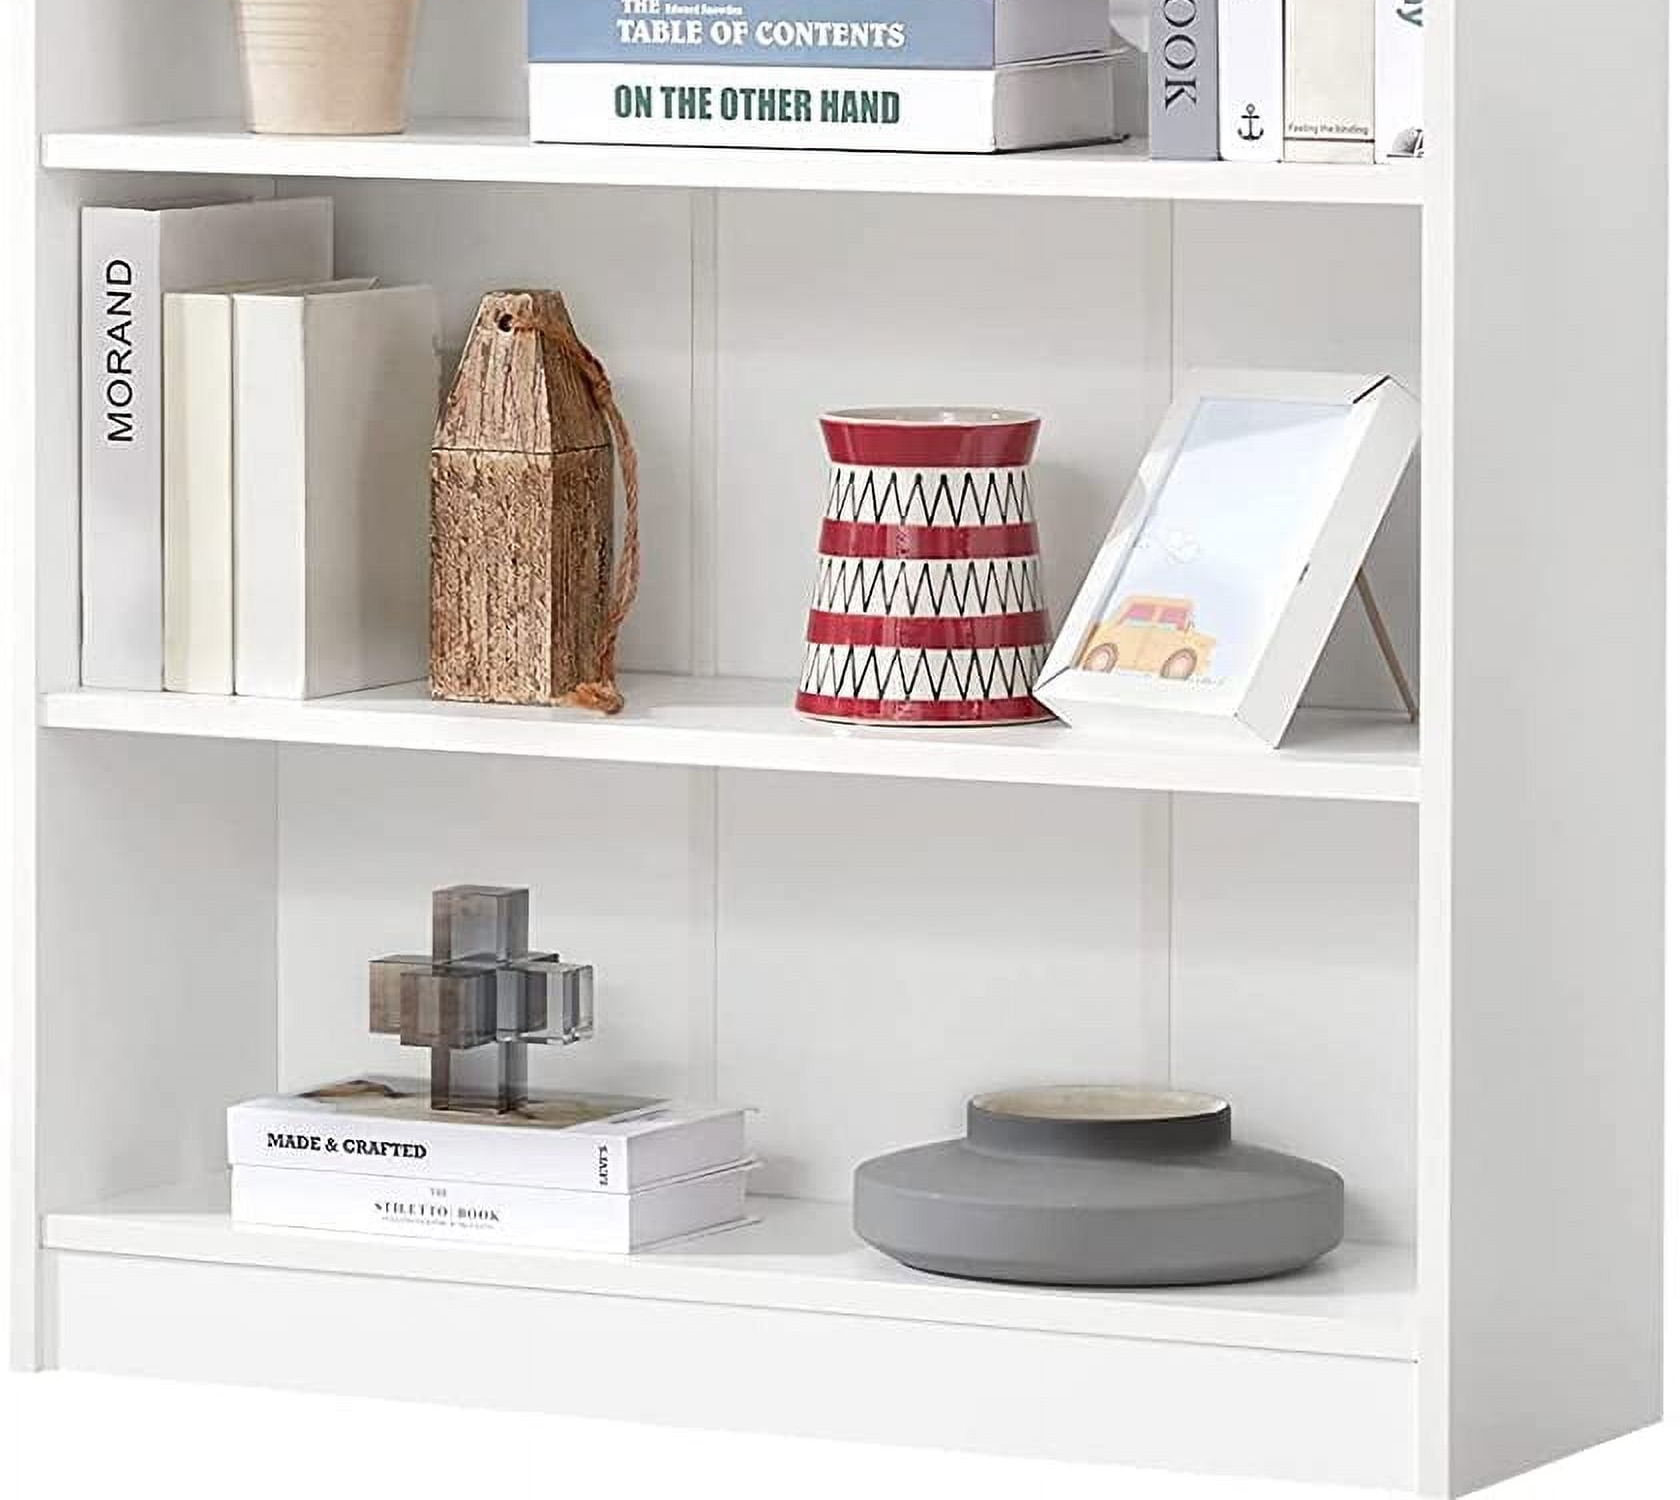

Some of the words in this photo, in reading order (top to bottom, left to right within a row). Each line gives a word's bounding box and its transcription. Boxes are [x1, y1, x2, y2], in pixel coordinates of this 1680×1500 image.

[616, 19, 702, 44] TABLE
[710, 20, 748, 45] OF
[754, 21, 906, 48] CONTENTS
[614, 84, 652, 118] ON
[660, 86, 712, 119] THE
[720, 87, 812, 122] OTHER
[820, 90, 900, 124] HAND
[105, 259, 133, 442] MORAND
[267, 1132, 321, 1152] MADE
[325, 1135, 339, 1154] &
[342, 1138, 427, 1160] CRAFTED
[458, 1207, 500, 1222] BOOK
